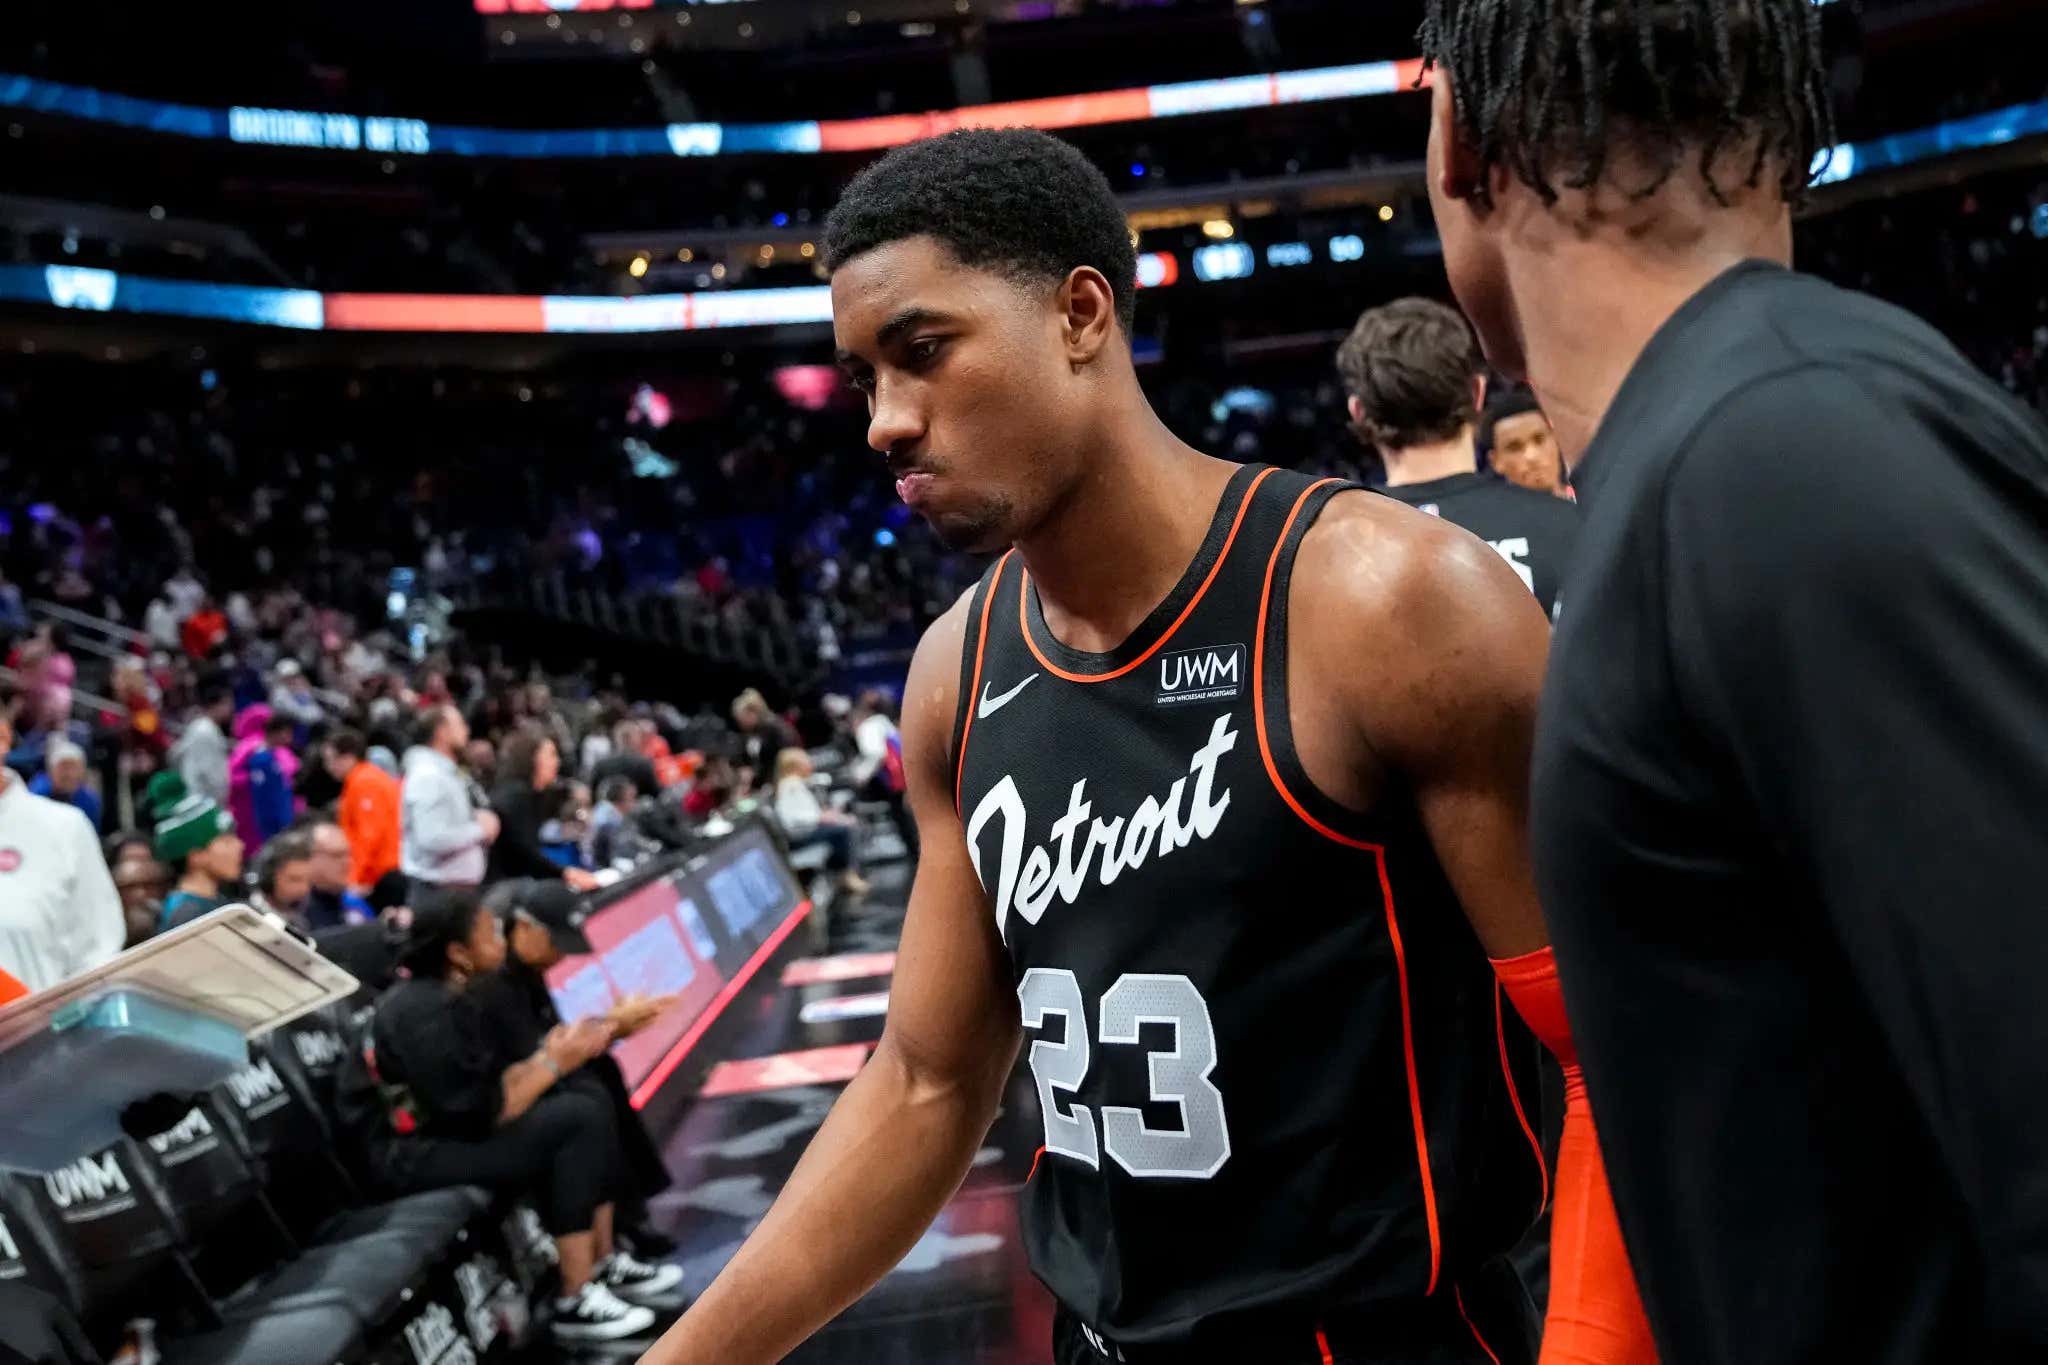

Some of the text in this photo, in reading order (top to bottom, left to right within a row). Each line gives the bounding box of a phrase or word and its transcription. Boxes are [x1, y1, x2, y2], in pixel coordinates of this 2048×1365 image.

[1157, 688, 1237, 704] UNITED WHOLESALE MORTGAGE
[1161, 649, 1238, 690] UWM
[966, 712, 1239, 948] Detroit
[1017, 967, 1231, 1179] 23
[45, 1151, 130, 1208] UWM
